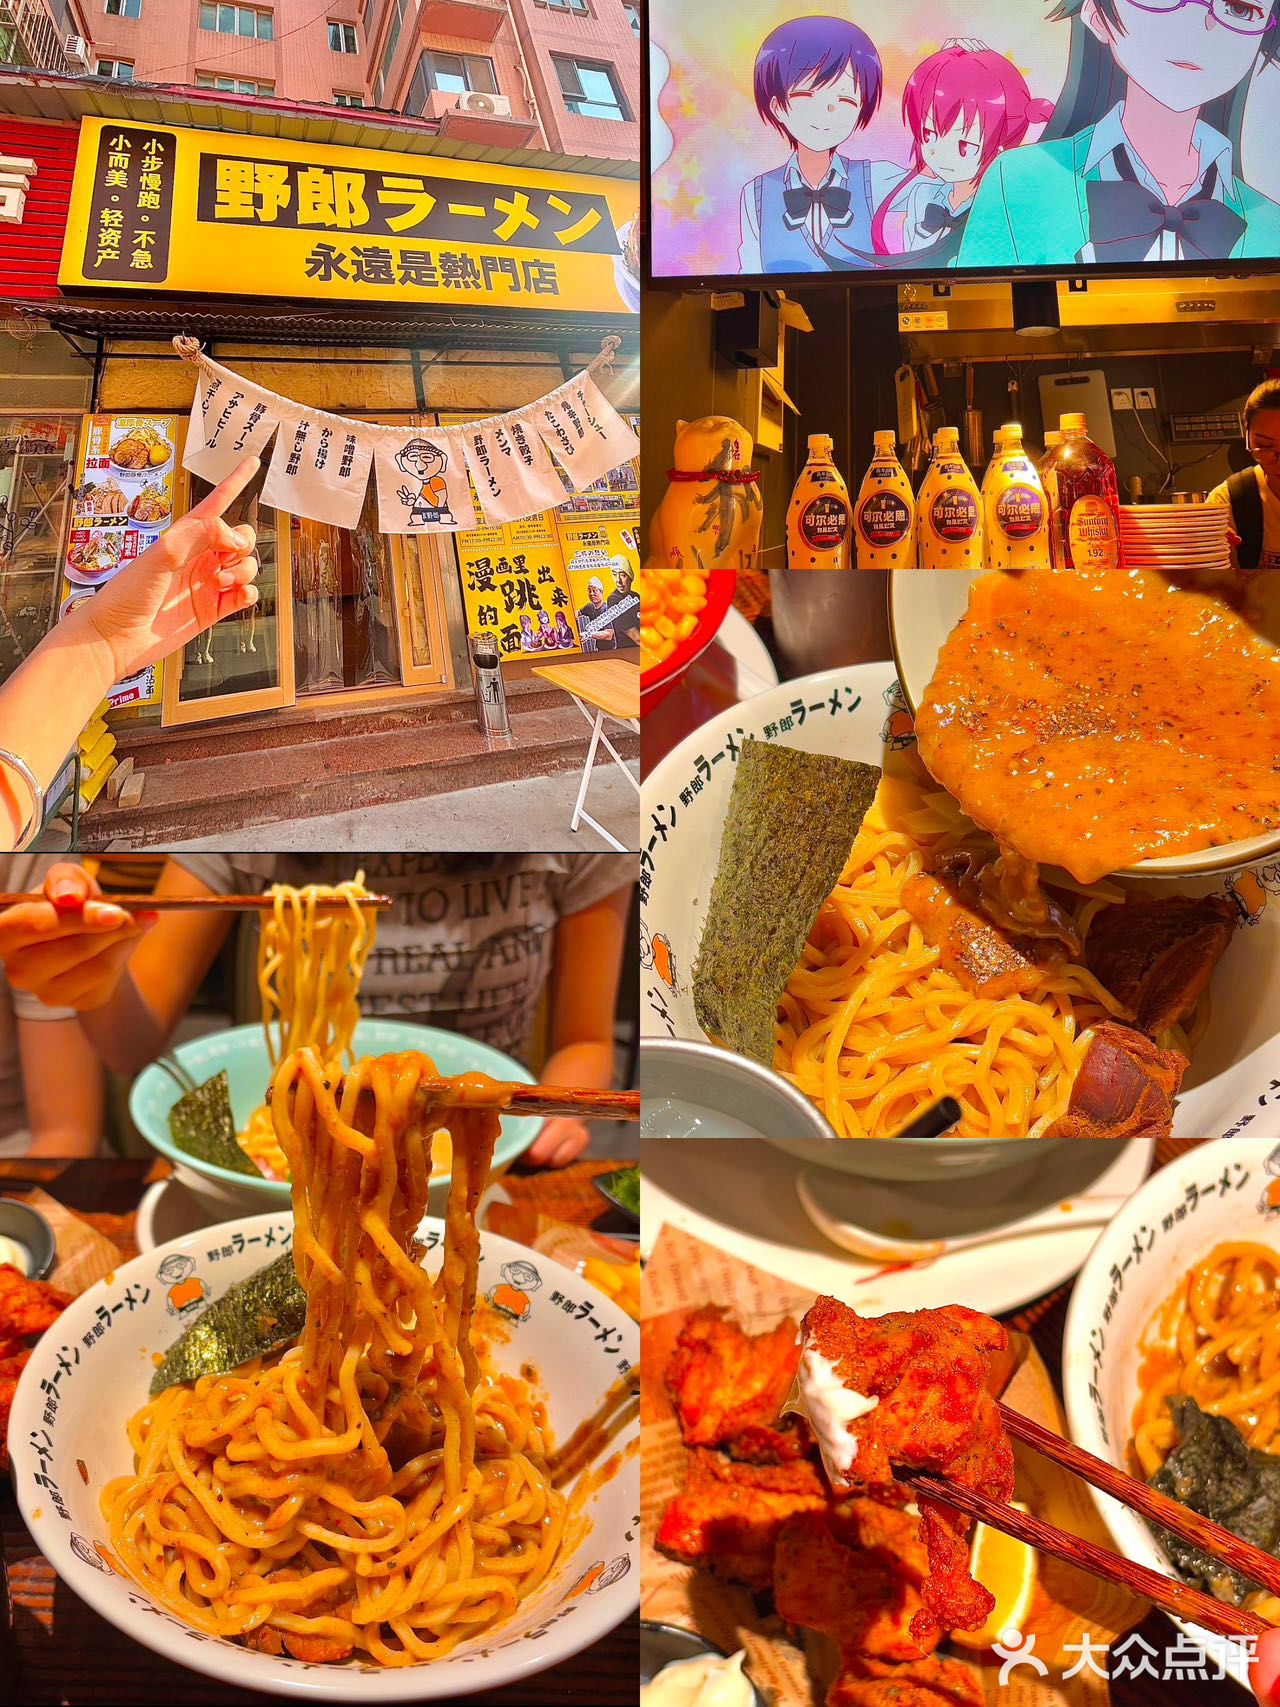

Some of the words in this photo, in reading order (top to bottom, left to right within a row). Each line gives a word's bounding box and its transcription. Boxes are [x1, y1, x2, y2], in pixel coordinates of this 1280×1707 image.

[214, 158, 602, 246] 野郎ラーメン
[305, 242, 560, 296] 永遠是熱門店
[86, 457, 110, 469] 拉面
[285, 420, 311, 476] 汁無し野郎
[338, 434, 357, 478] 味噌野郎
[473, 434, 502, 498] 野郎ラーメン
[495, 428, 512, 456] メンマ
[805, 513, 846, 527] 可尔必思
[863, 509, 906, 523] 可尔必思
[933, 505, 977, 519] 可尔必思
[997, 502, 1041, 516] 可尔必思
[1077, 516, 1109, 527] Suntory
[1078, 526, 1109, 537] Whisky
[763, 686, 862, 740] 野郎ラーメン
[401, 887, 450, 926] TO
[461, 870, 531, 919] LIVE
[1161, 1163, 1250, 1232] 野郎ラーメン
[207, 1225, 292, 1263] 野郎ラーメン
[82, 1283, 151, 1349] 野郎ラーメン
[549, 1290, 623, 1354] 野郎ラーメン
[40, 1346, 81, 1428] 野郎ラーメン
[30, 1430, 73, 1521] 野郎ラーメン
